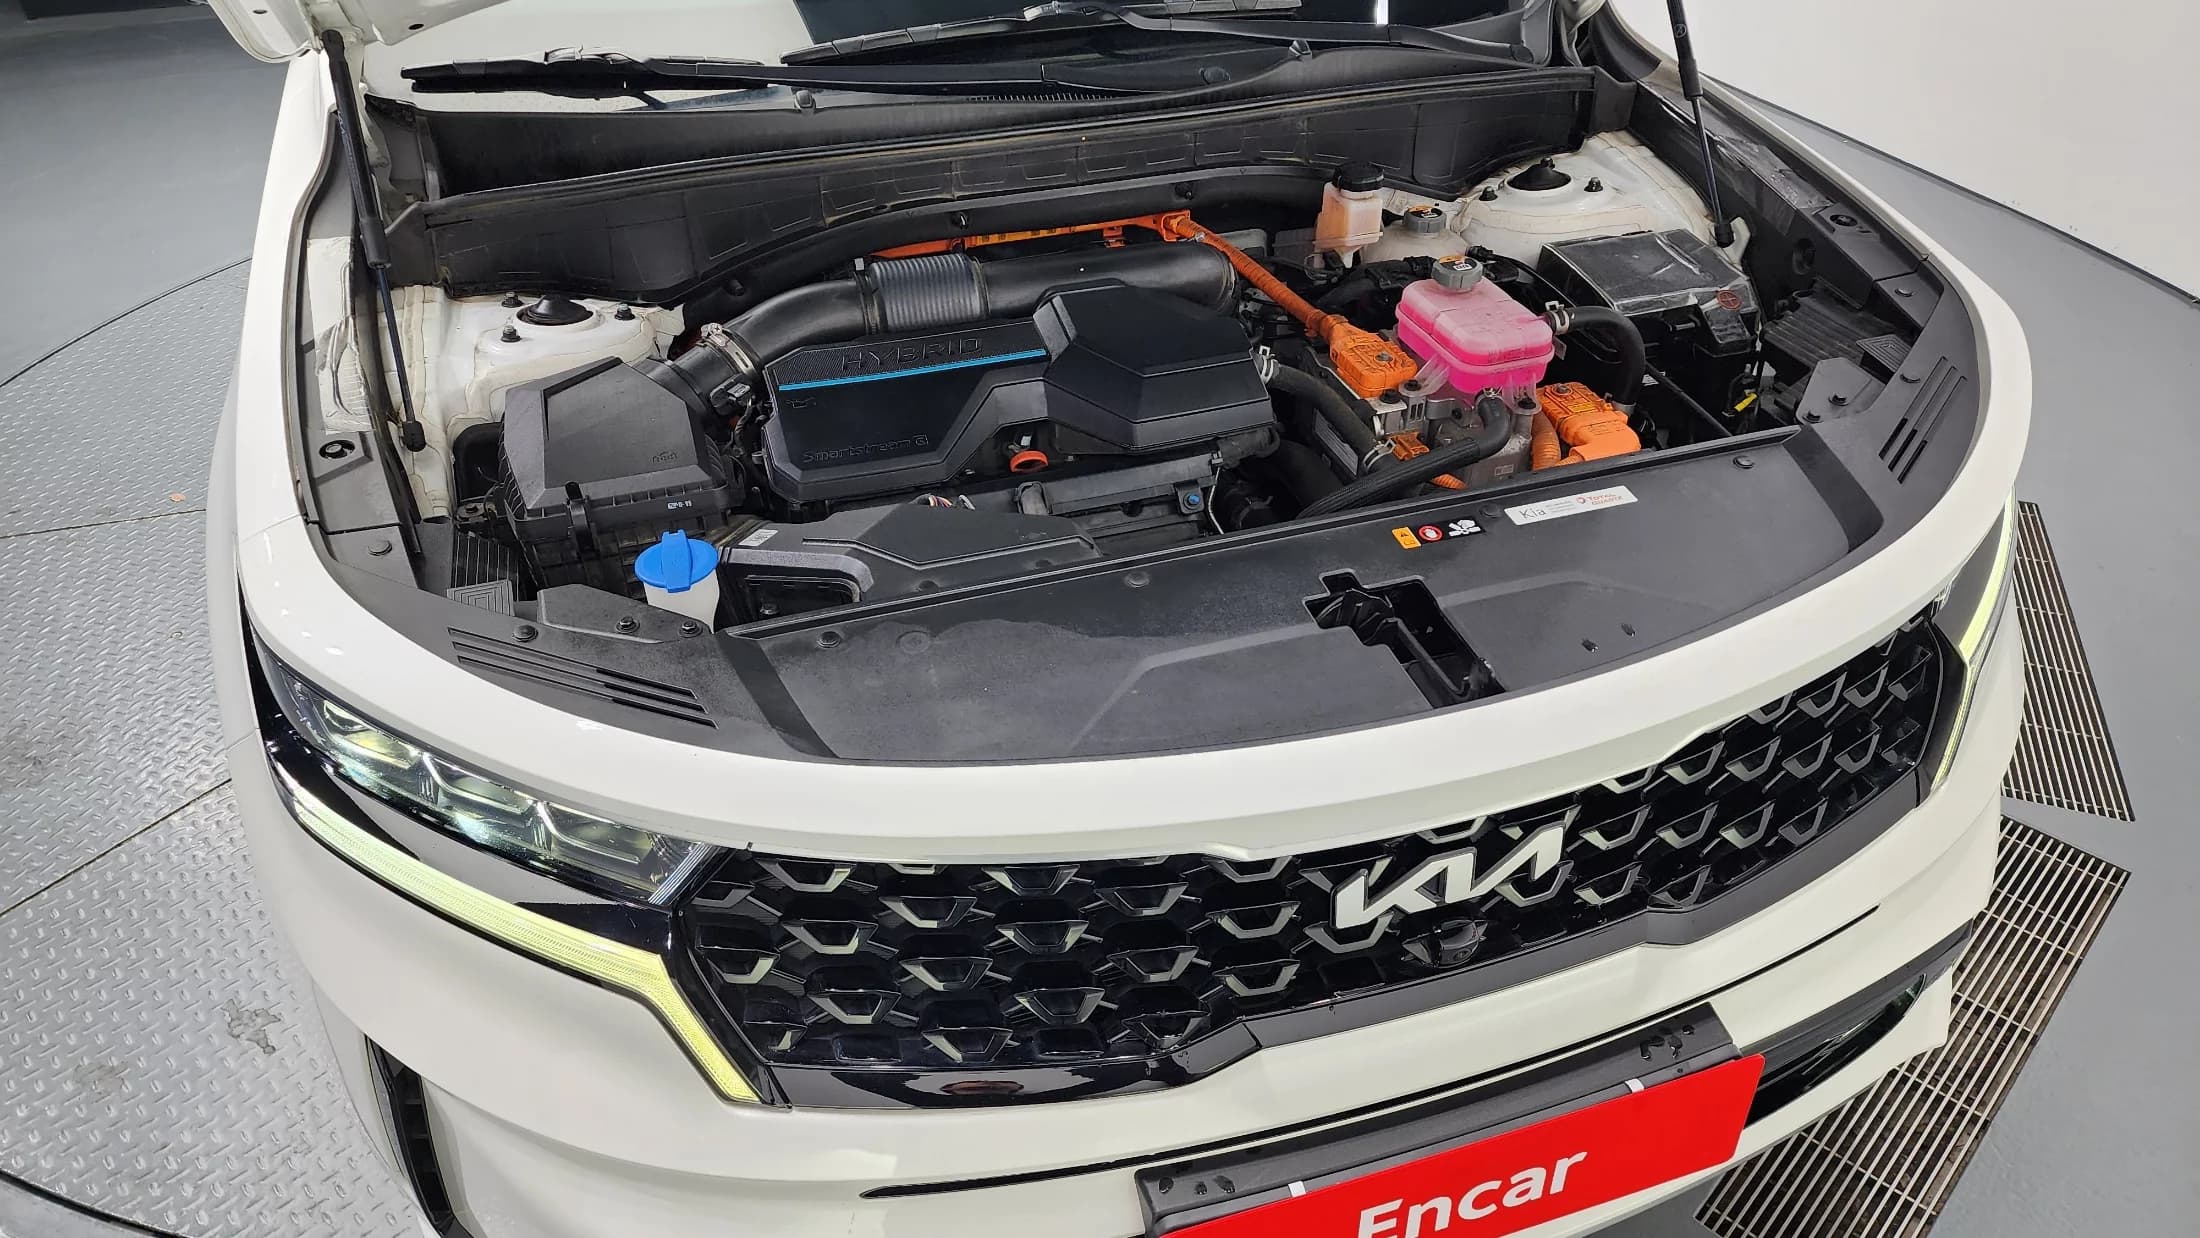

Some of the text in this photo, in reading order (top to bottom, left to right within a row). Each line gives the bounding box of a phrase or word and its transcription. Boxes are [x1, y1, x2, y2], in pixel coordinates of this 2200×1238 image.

[841, 338, 982, 371] HYBRID
[803, 439, 911, 463] Smartstream
[1519, 507, 1547, 520] Kia
[1333, 823, 1565, 929] KIA
[1357, 1151, 1588, 1238] Encar
